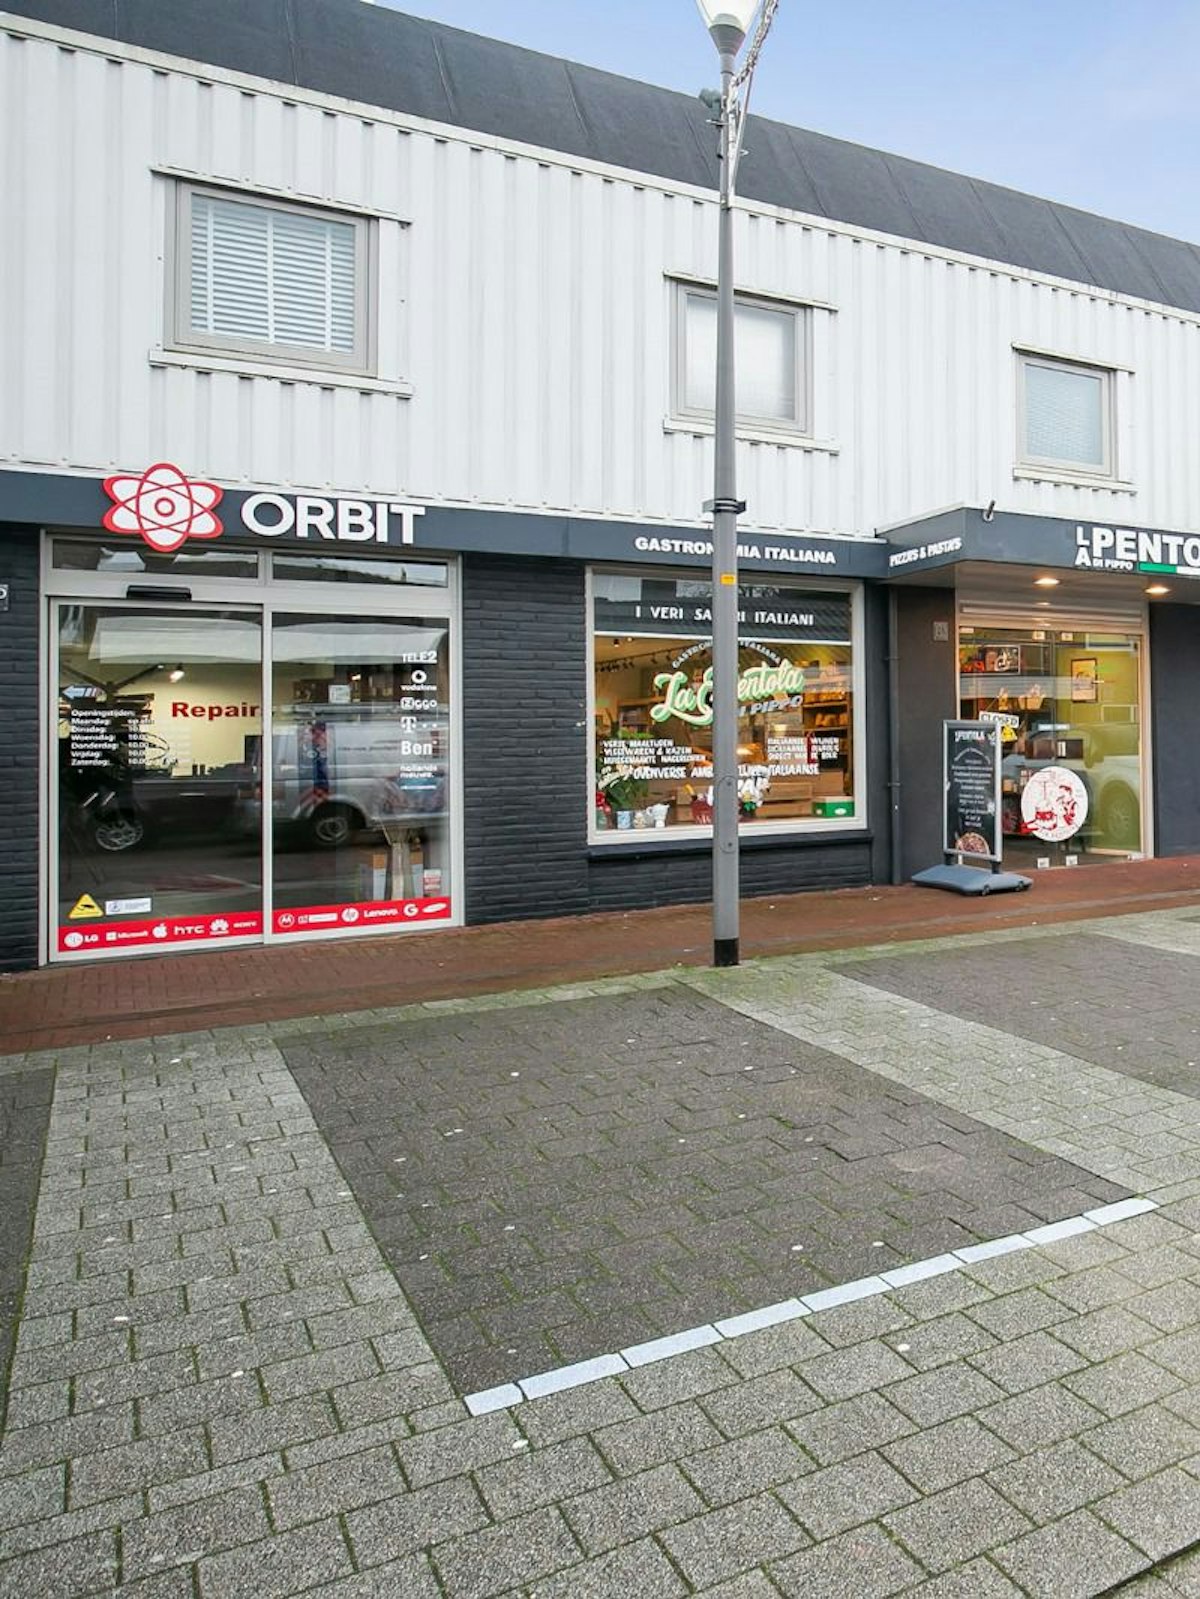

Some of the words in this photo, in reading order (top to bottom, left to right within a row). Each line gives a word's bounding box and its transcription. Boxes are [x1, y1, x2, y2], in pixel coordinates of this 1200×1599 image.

[241, 493, 426, 544] ORBIT
[635, 536, 761, 559] GASTRONMIA
[764, 547, 836, 565] ITALIANA
[919, 546, 927, 559] &
[1104, 559, 1134, 571] PIPPO
[650, 606, 683, 620] VERI
[754, 611, 814, 626] ITALIANI
[402, 650, 438, 664] TELE2
[172, 702, 260, 721] Repair
[750, 694, 804, 715] PIPPO
[401, 740, 433, 756] Ben
